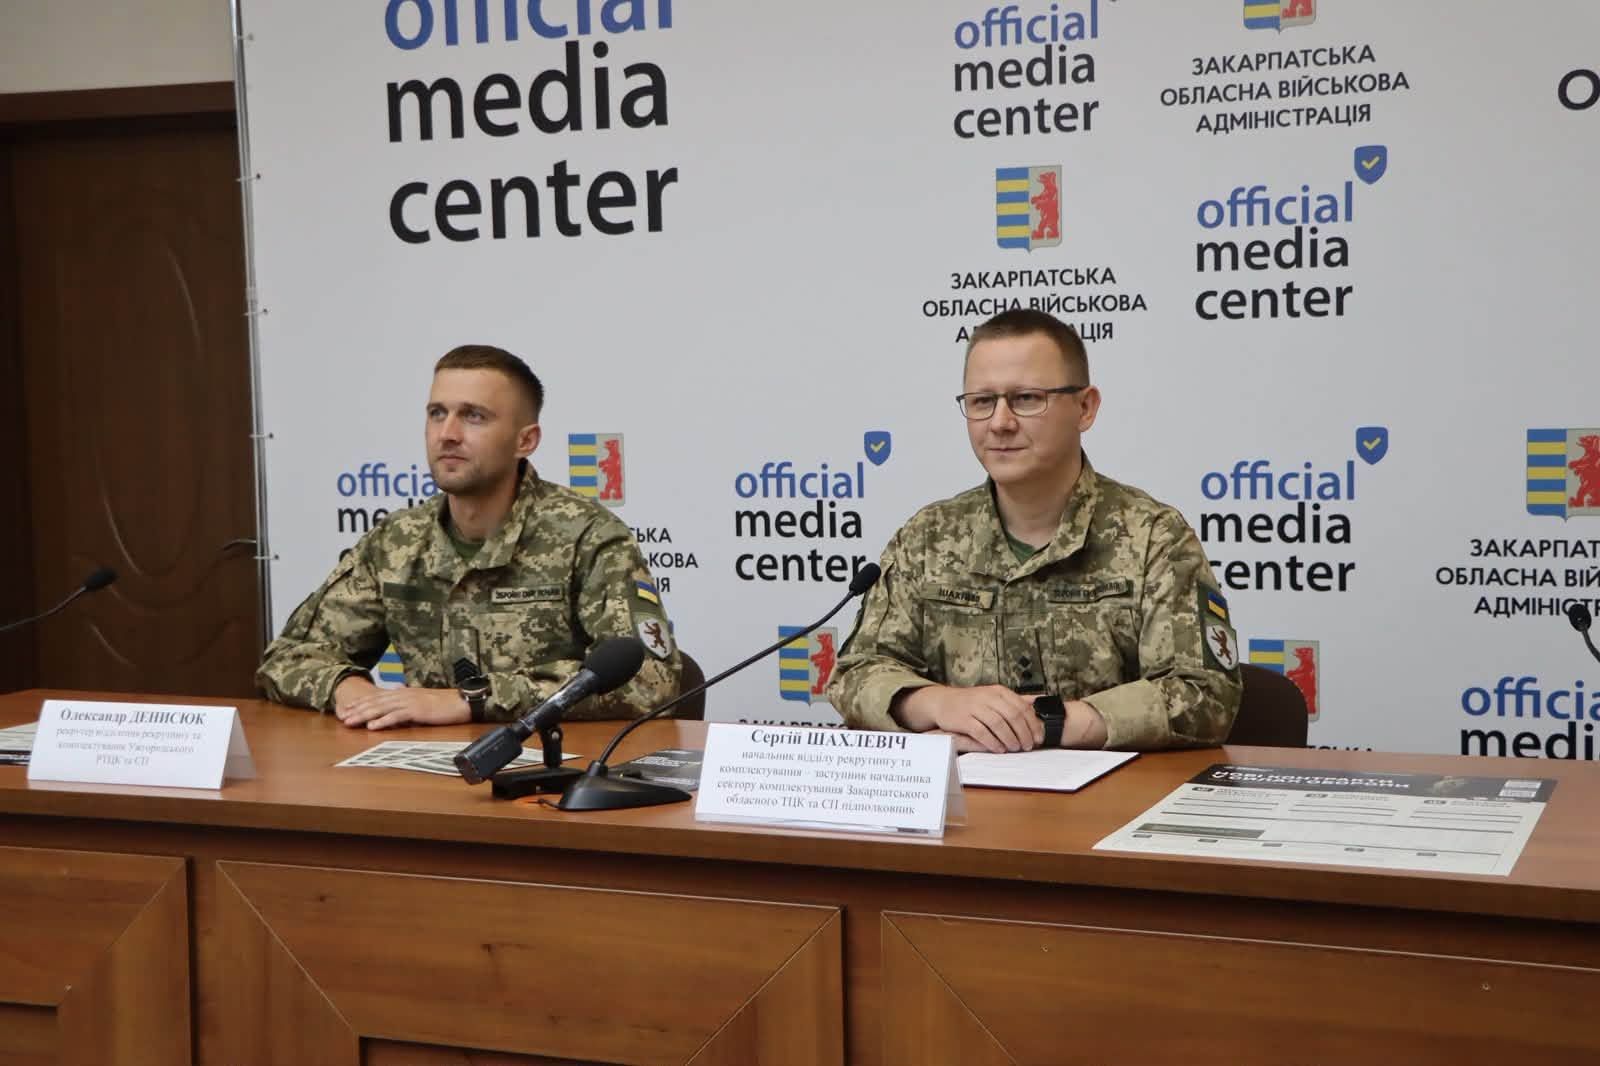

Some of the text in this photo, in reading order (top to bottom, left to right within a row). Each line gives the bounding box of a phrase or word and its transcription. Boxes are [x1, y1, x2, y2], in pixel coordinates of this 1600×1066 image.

[955, 0, 1098, 49] official
[955, 44, 1095, 92] media
[1192, 45, 1376, 76] ЗАКАРПАТСЬКА
[387, 40, 668, 142] media
[1160, 72, 1410, 106] ОБЛАСНА ВІЙСЬКОВА
[954, 98, 1099, 139] center
[1196, 103, 1371, 134] АДМІНІСТРАЦІЯ
[390, 160, 678, 243] center
[1197, 181, 1353, 228] official
[1197, 226, 1348, 272] media
[951, 267, 1117, 289] ЗАКАРПАТСЬКА
[1029, 293, 1148, 313] ВІЙСЬКОВА
[1195, 281, 1353, 320] center
[337, 462, 439, 497] officia
[735, 461, 864, 498] official
[1201, 460, 1355, 500] official
[735, 499, 862, 538] media
[1200, 502, 1351, 543] media
[735, 549, 866, 582] center
[1435, 567, 1557, 587] ОБЛАСНА
[60, 708, 207, 726] Олександр ДЕНИСЮК
[751, 728, 907, 750] Сергій ШАХЛЕВІЧ
[1461, 721, 1600, 761] medi
[719, 765, 802, 777] комплектування
[815, 770, 867, 782] заступник
[870, 773, 931, 784] начальника
[742, 751, 912, 768] начальник відділу рекрутингу та
[717, 780, 929, 800] сектору комплектування Закарпатського
[726, 794, 916, 815] обласного ТЦК та СП підполковник
